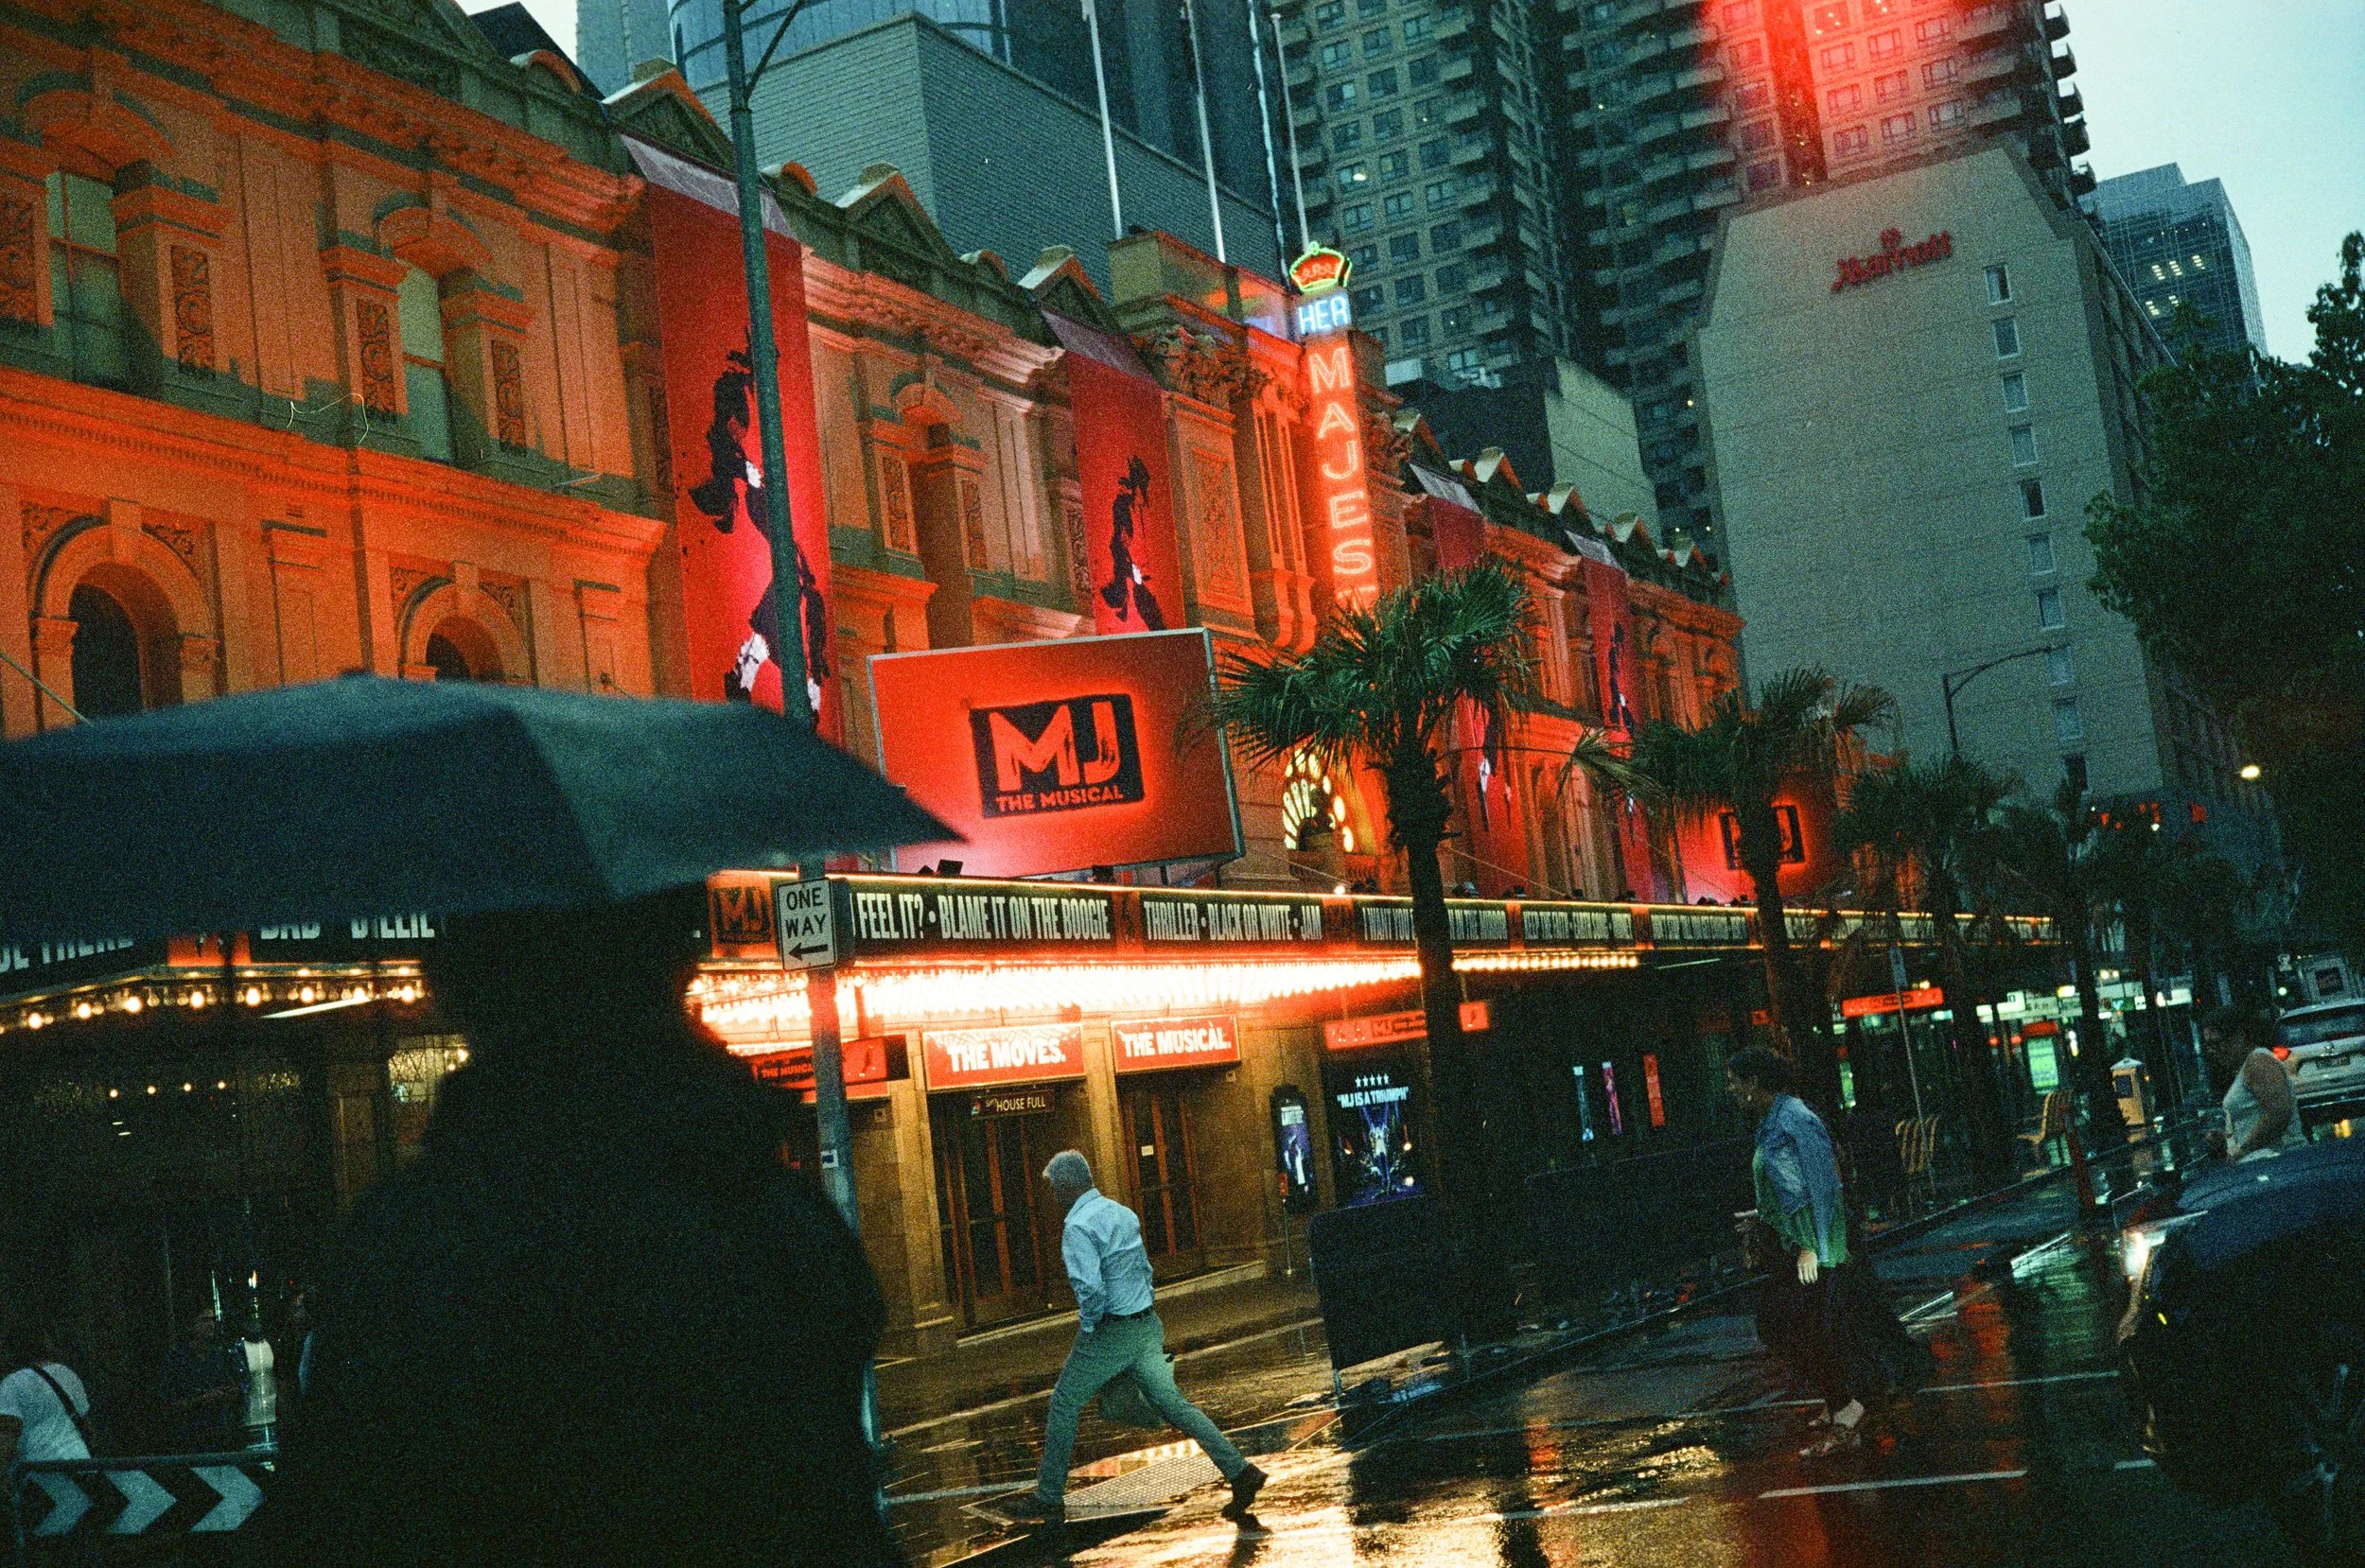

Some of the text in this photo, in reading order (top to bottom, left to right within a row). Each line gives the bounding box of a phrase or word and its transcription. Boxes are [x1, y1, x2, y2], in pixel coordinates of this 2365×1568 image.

[1298, 296, 1349, 335] HER
[989, 700, 1121, 793] MJ
[995, 785, 1125, 812] THE MUSICAL
[717, 887, 764, 932] MJ
[786, 887, 823, 911] ONE
[785, 914, 827, 939] WAY
[856, 893, 900, 939] FEEL
[898, 893, 924, 939] IT?
[937, 895, 991, 939] BLAME
[990, 896, 1007, 939] IT
[1008, 896, 1032, 940] ON
[1031, 897, 1060, 940] THE
[1060, 897, 1111, 940] BOOGIE
[1144, 901, 1323, 941] THRILLER BLACK OR WHITE JAM
[946, 1038, 1066, 1072] THE MOVES.
[1122, 1027, 1232, 1057] THE MUSICAL.
[996, 1098, 1025, 1112] HOUSE
[1026, 1095, 1045, 1108] FULL
[1364, 1091, 1371, 1106] A
